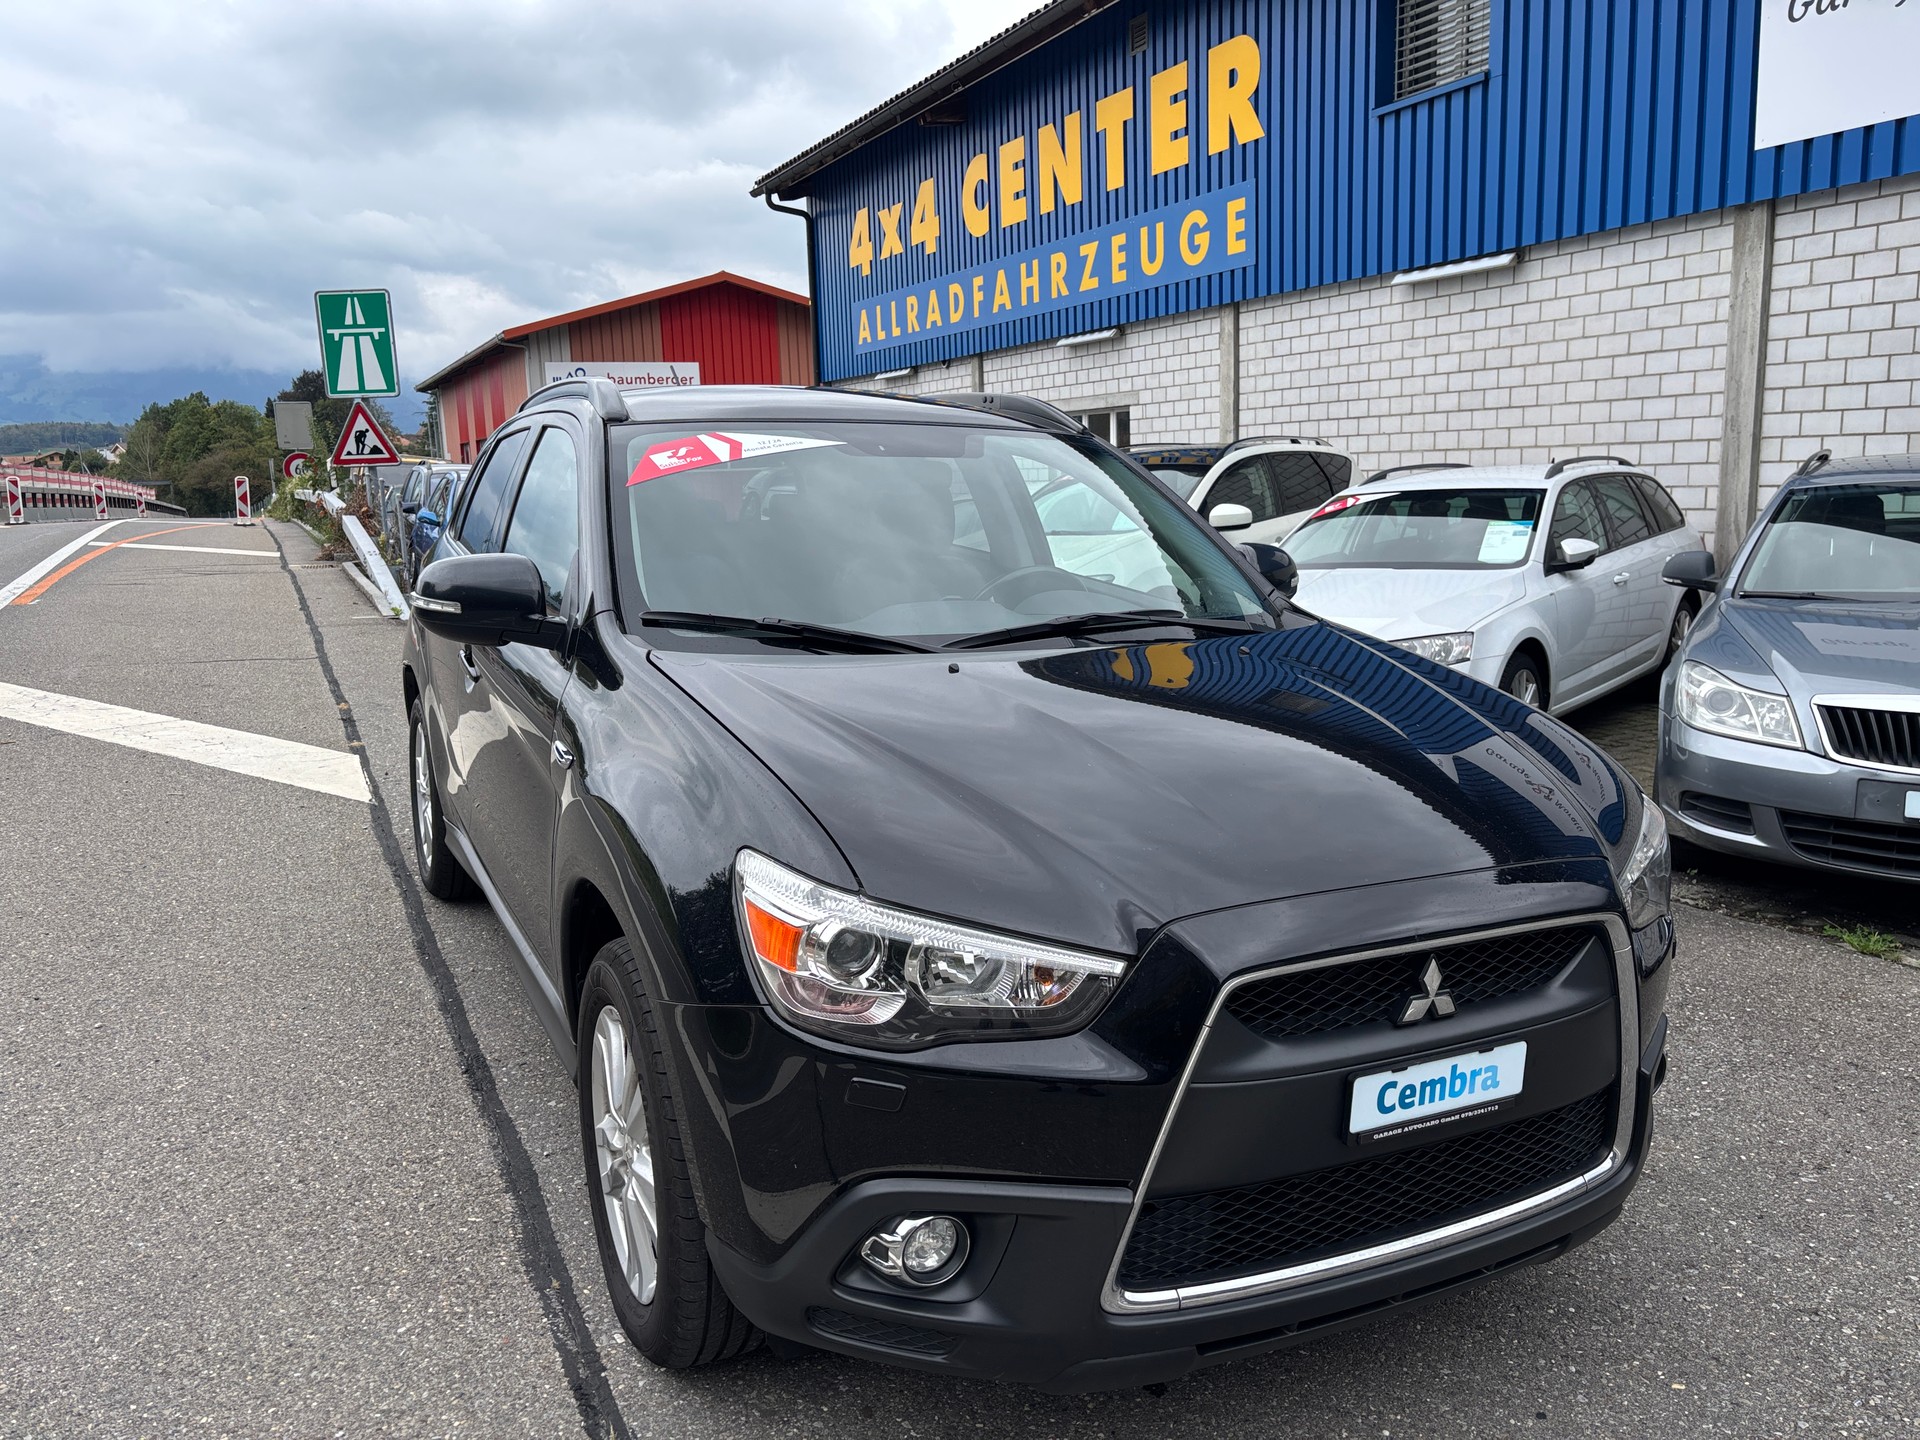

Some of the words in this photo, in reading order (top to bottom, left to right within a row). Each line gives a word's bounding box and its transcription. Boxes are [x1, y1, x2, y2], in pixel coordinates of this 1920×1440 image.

[849, 177, 940, 277] 4x4
[962, 34, 1266, 238] CENTER
[858, 197, 1247, 345] ALLRADFAHRZEUGE
[1373, 1128, 1402, 1139] GARAGE
[1377, 1063, 1500, 1114] Cembra
